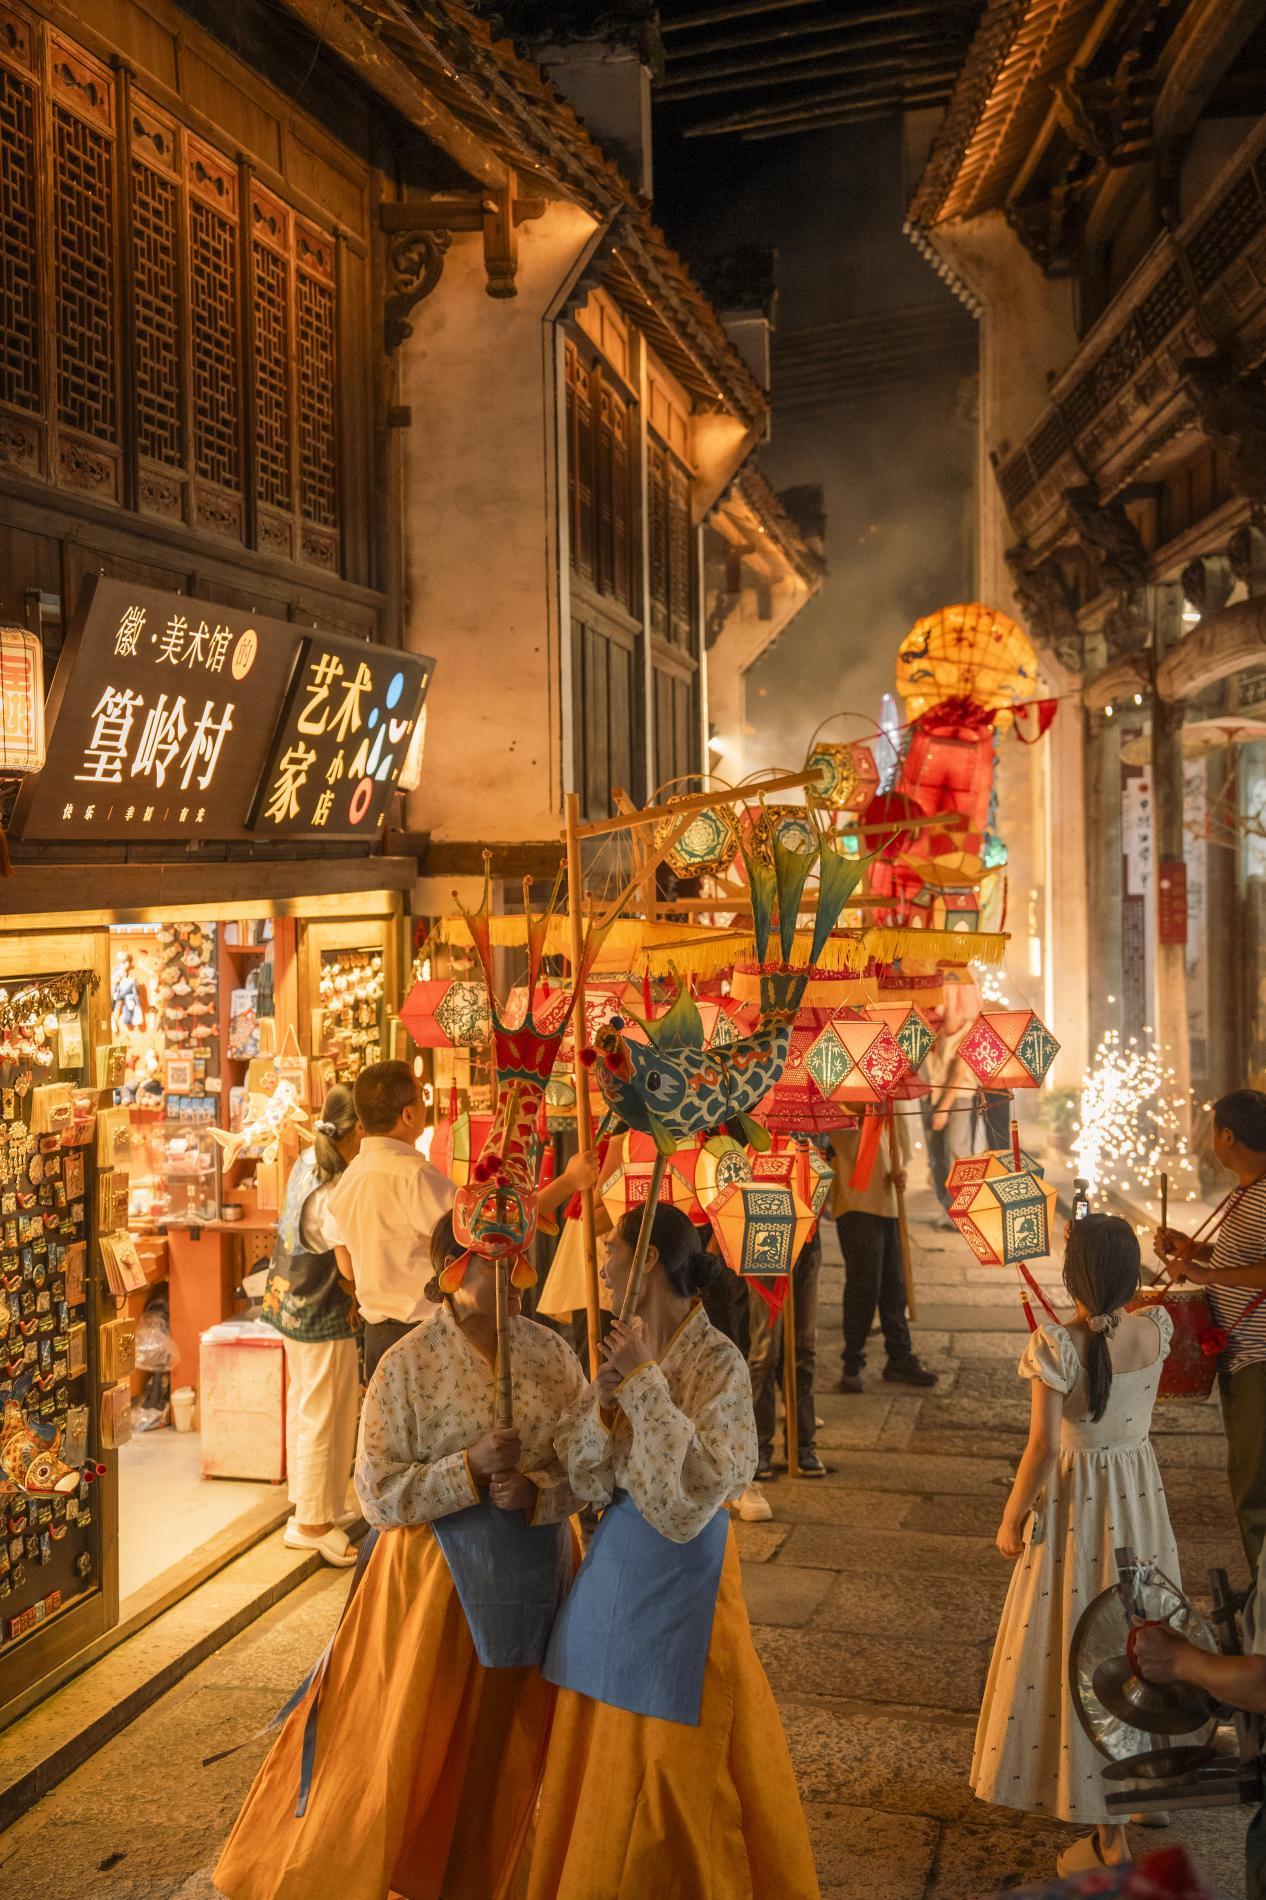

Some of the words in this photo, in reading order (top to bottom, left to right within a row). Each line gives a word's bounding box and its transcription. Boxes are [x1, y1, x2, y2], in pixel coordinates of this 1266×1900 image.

[74, 685, 235, 790] 篁岭村
[297, 653, 373, 743] 艺术
[264, 740, 317, 824] 家
[310, 749, 345, 826] 小店
